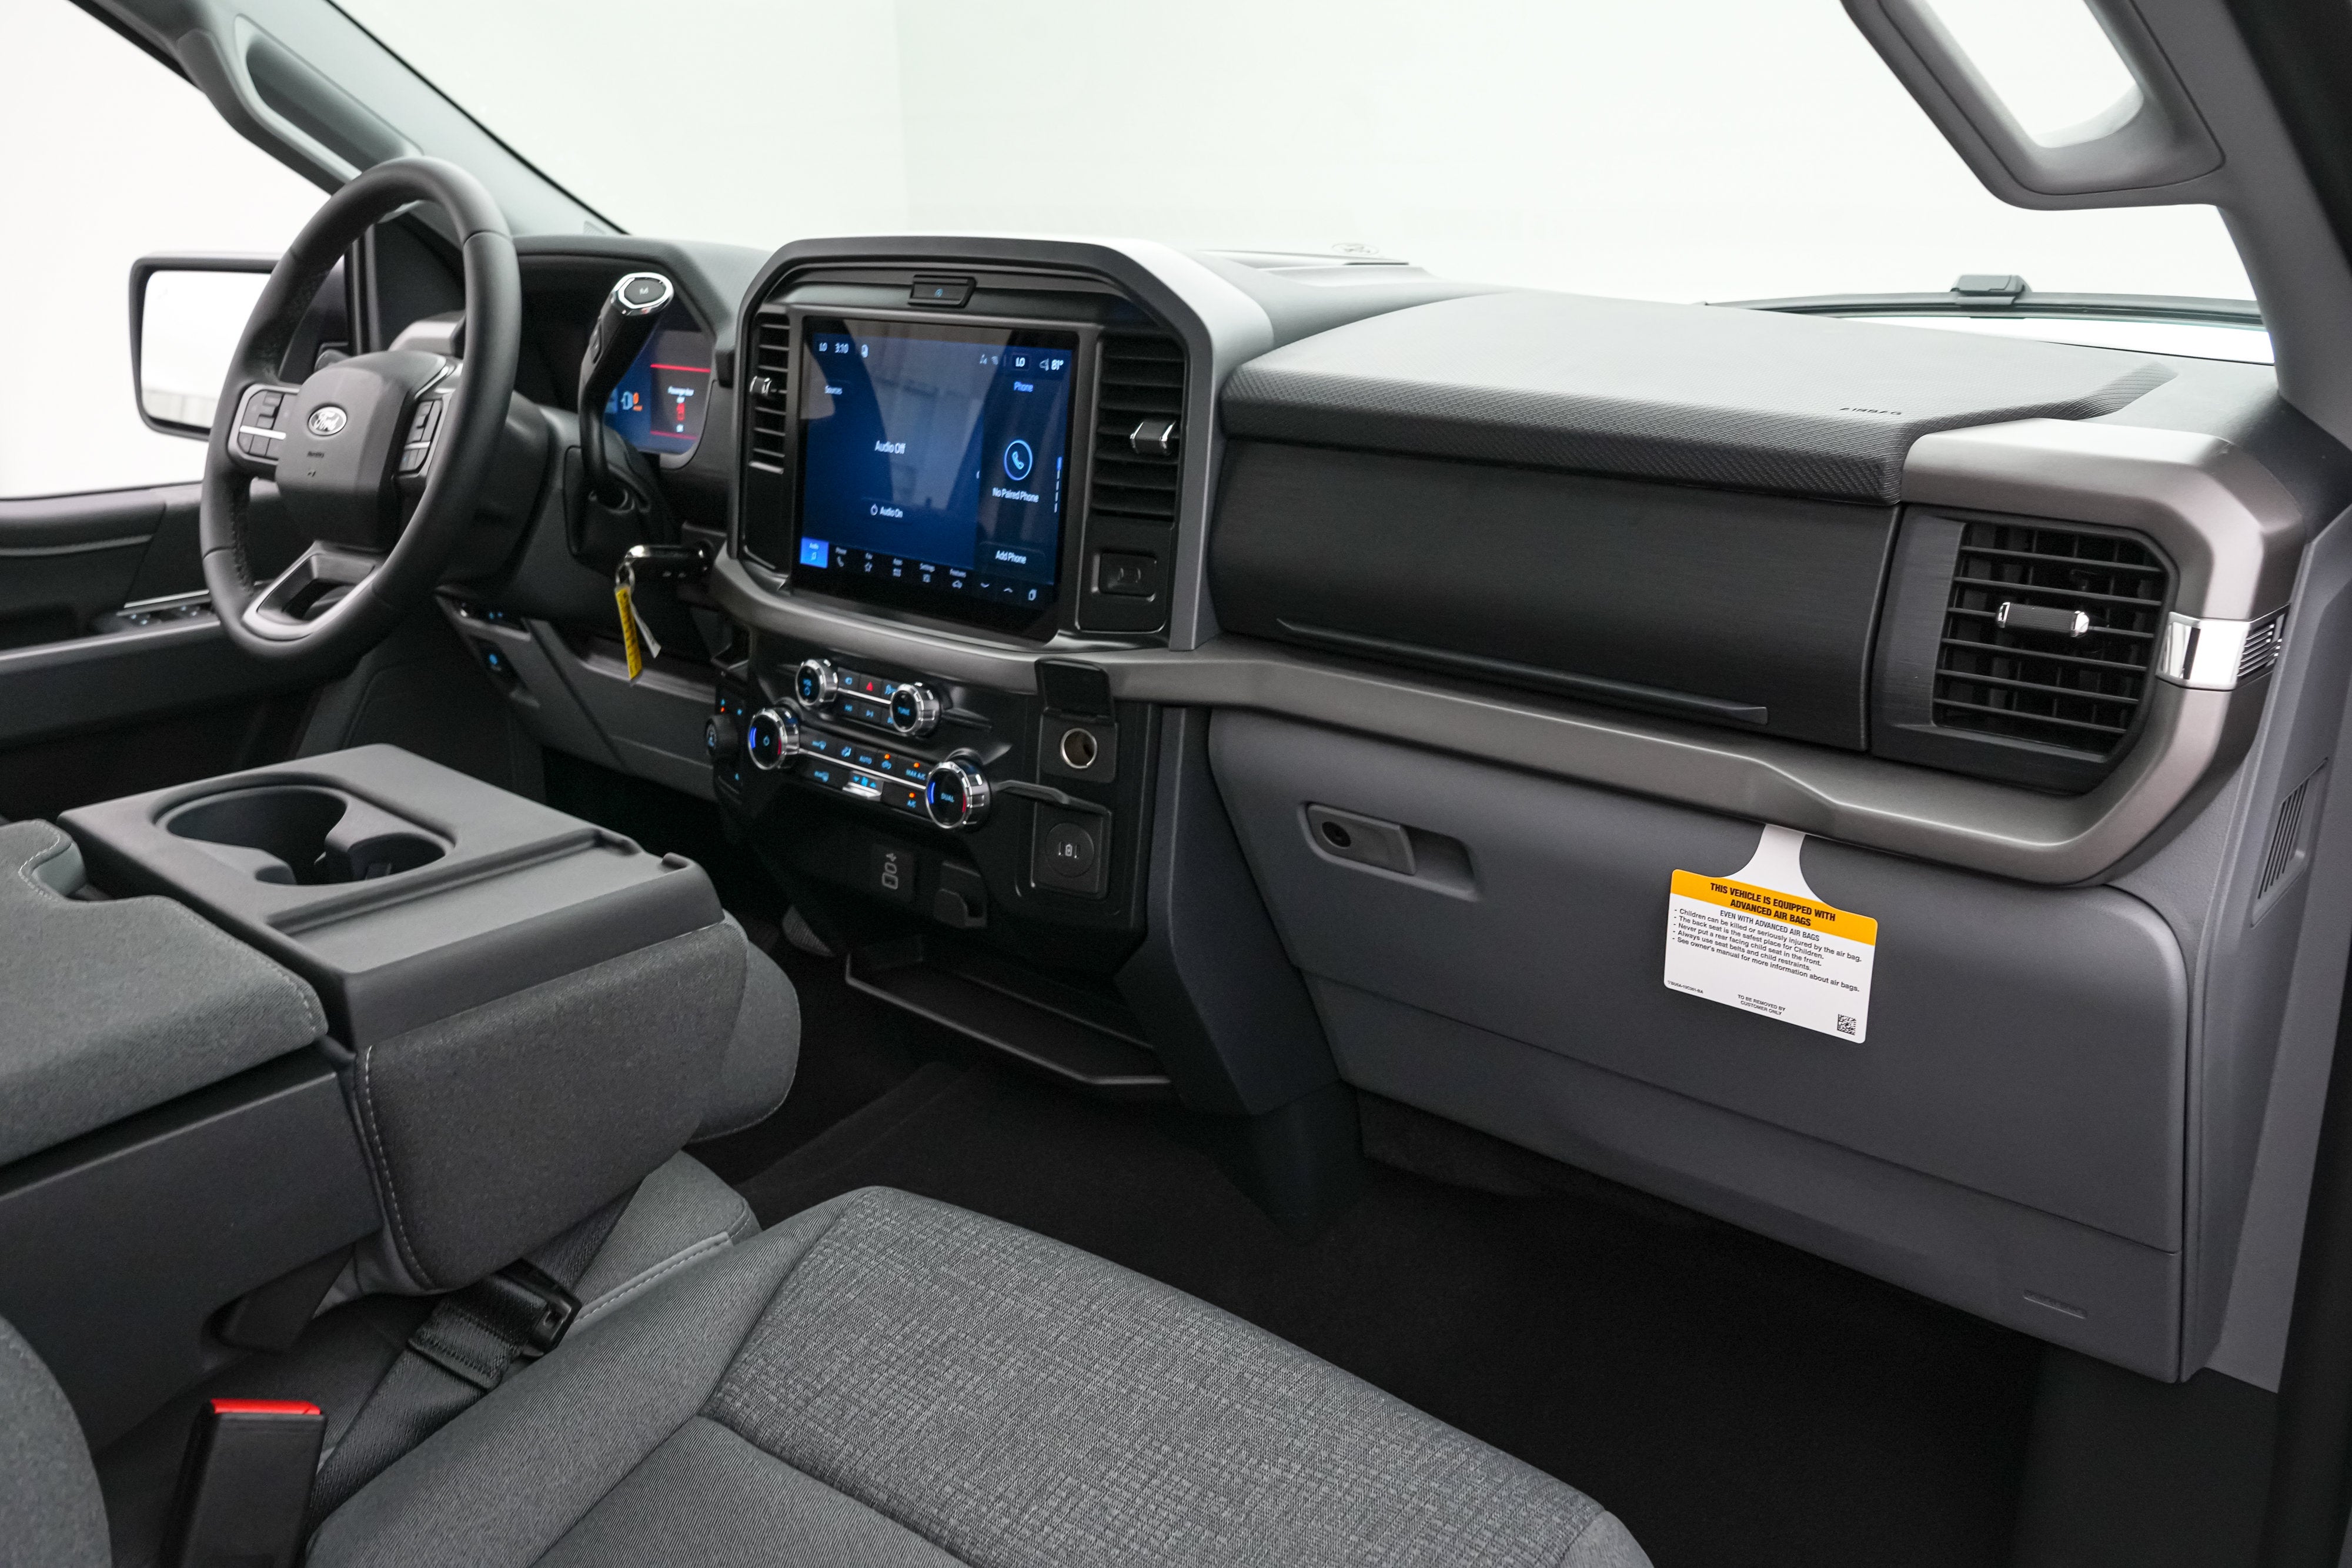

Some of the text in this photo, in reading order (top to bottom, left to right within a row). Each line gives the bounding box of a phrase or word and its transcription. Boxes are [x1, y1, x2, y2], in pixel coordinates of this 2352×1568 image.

[1014, 381, 1034, 393] Phone
[313, 410, 340, 431] Ford
[875, 441, 906, 454] Audio Off
[993, 487, 1040, 503] No Paired Phone
[880, 506, 903, 519] Audio On
[995, 550, 1027, 564] Add Phone
[906, 769, 917, 778] MAX
[907, 800, 916, 808] A/C
[941, 793, 954, 803] DUAL
[1710, 882, 1836, 922] THIS VEHICLE IS EQUIPPED WITH
[1730, 899, 1811, 927] ADVANCED AIR BAGS
[1720, 910, 1819, 942] EVEN WITH ADVANCED AIR BAGS
[1679, 908, 1706, 920] Children
[1730, 921, 1748, 931] killed
[1757, 930, 1788, 943] seriously
[1789, 937, 1812, 948] injured
[1813, 944, 1823, 952] by
[1823, 947, 1835, 955] the
[1846, 952, 1862, 962] bag.
[1679, 915, 1690, 924] The
[1692, 919, 1708, 928] back
[1742, 934, 1762, 942] safest
[1763, 939, 1782, 948] place
[1793, 946, 1824, 959] Children.
[1678, 922, 1697, 932] Never
[1698, 929, 1709, 937] put
[1729, 936, 1749, 948] facing
[1750, 943, 1767, 951] child
[1804, 956, 1822, 967] front.
[1678, 930, 1700, 941] Always
[1729, 944, 1745, 953] belts
[1760, 953, 1777, 961] child
[1778, 958, 1811, 971] restraints.
[1677, 937, 1689, 945] See
[1690, 941, 1715, 952] owner's
[1716, 948, 1740, 959] manual
[1752, 958, 1769, 967] more
[1770, 962, 1808, 977] information
[1809, 974, 1829, 984] about
[1840, 982, 1860, 992] bags.
[1740, 1000, 1768, 1012] CUSTOMER
[1753, 999, 1778, 1009] REMOVED
